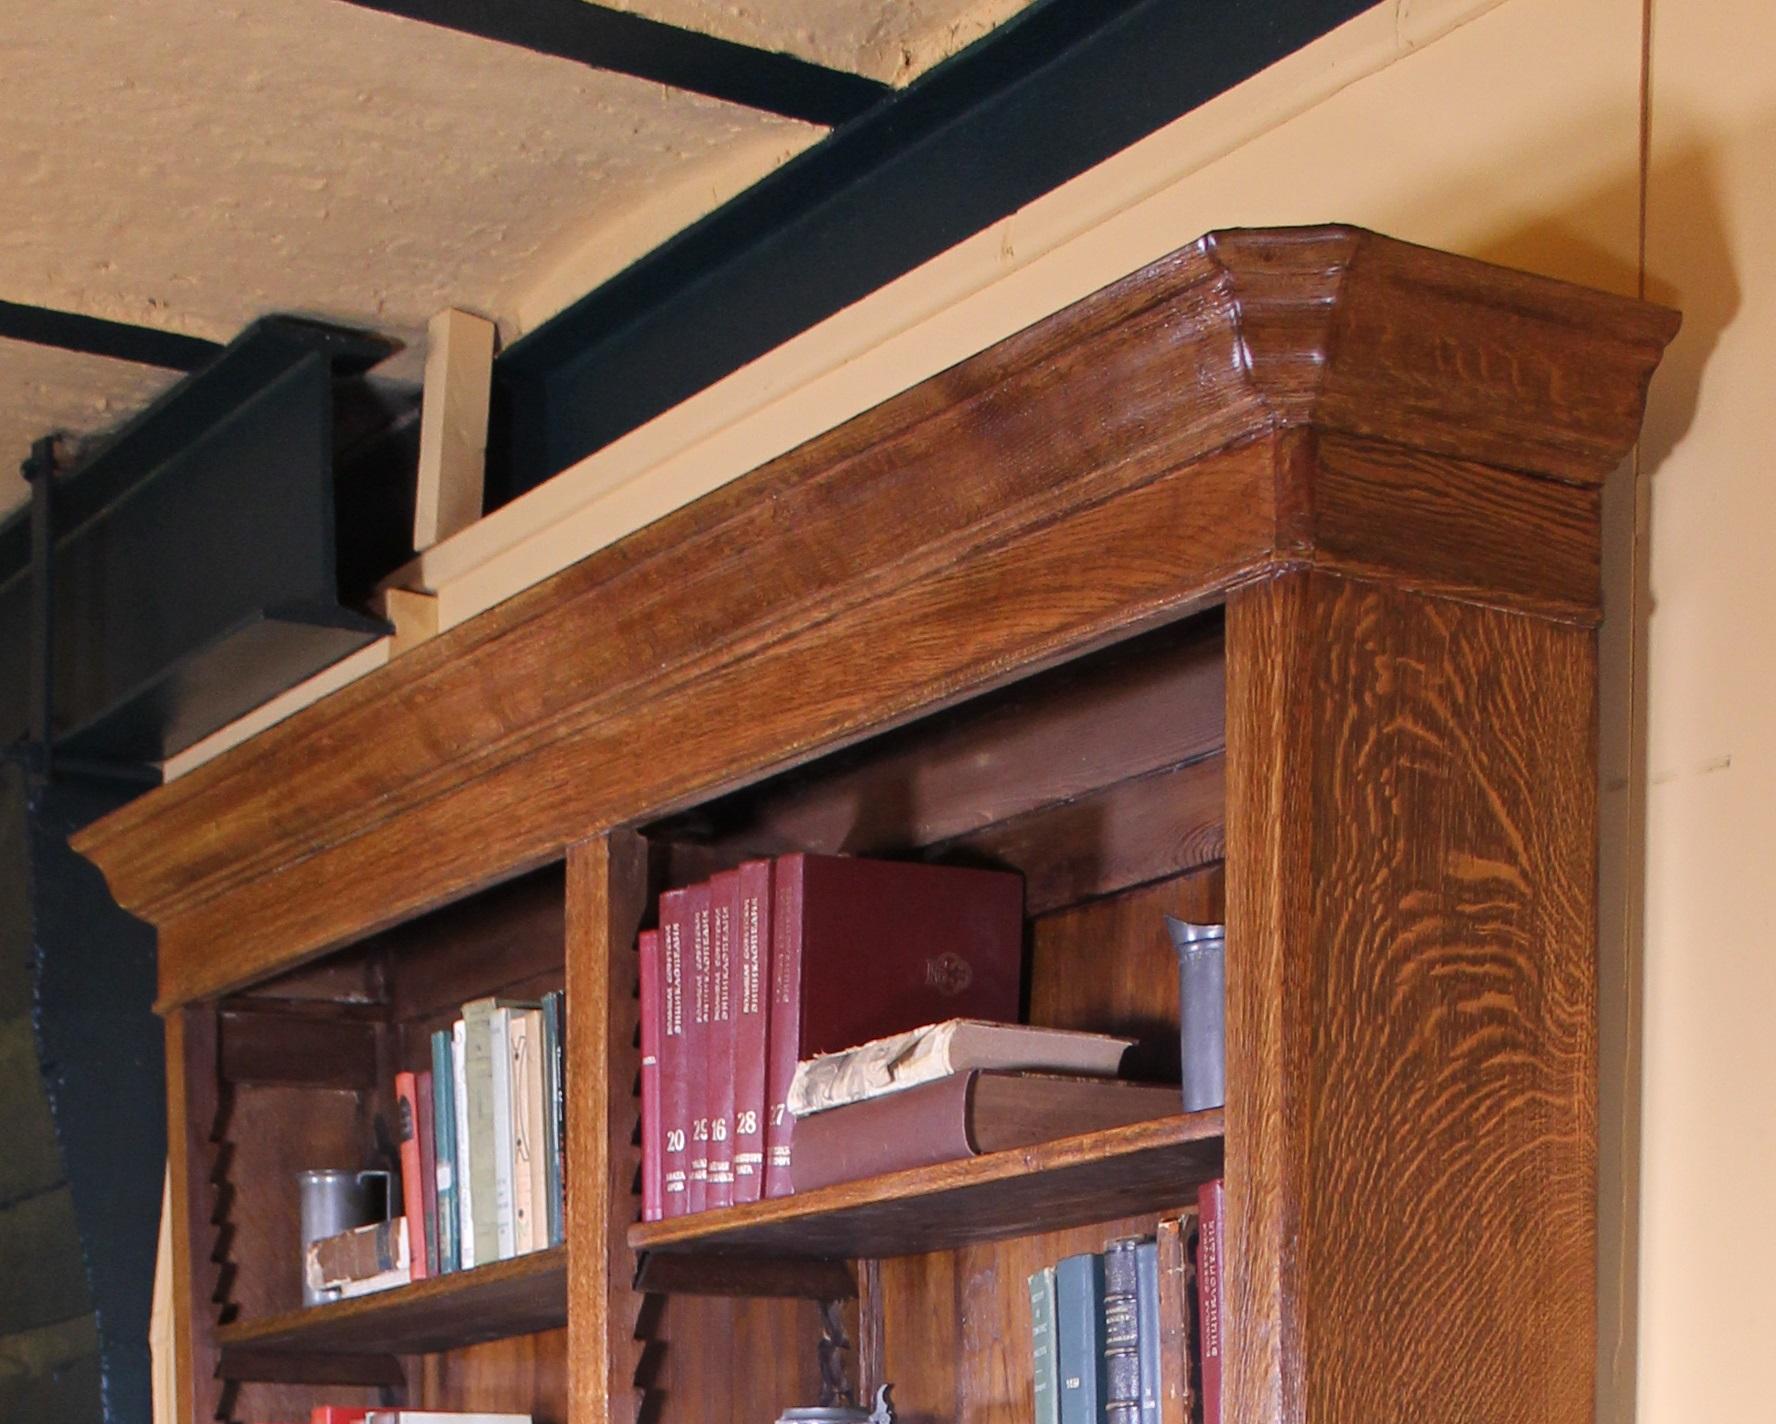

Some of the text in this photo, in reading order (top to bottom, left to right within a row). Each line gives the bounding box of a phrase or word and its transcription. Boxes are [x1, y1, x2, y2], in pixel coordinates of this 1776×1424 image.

[711, 1118, 727, 1141] 16
[736, 1110, 757, 1134] 28
[666, 1128, 685, 1152] 20
